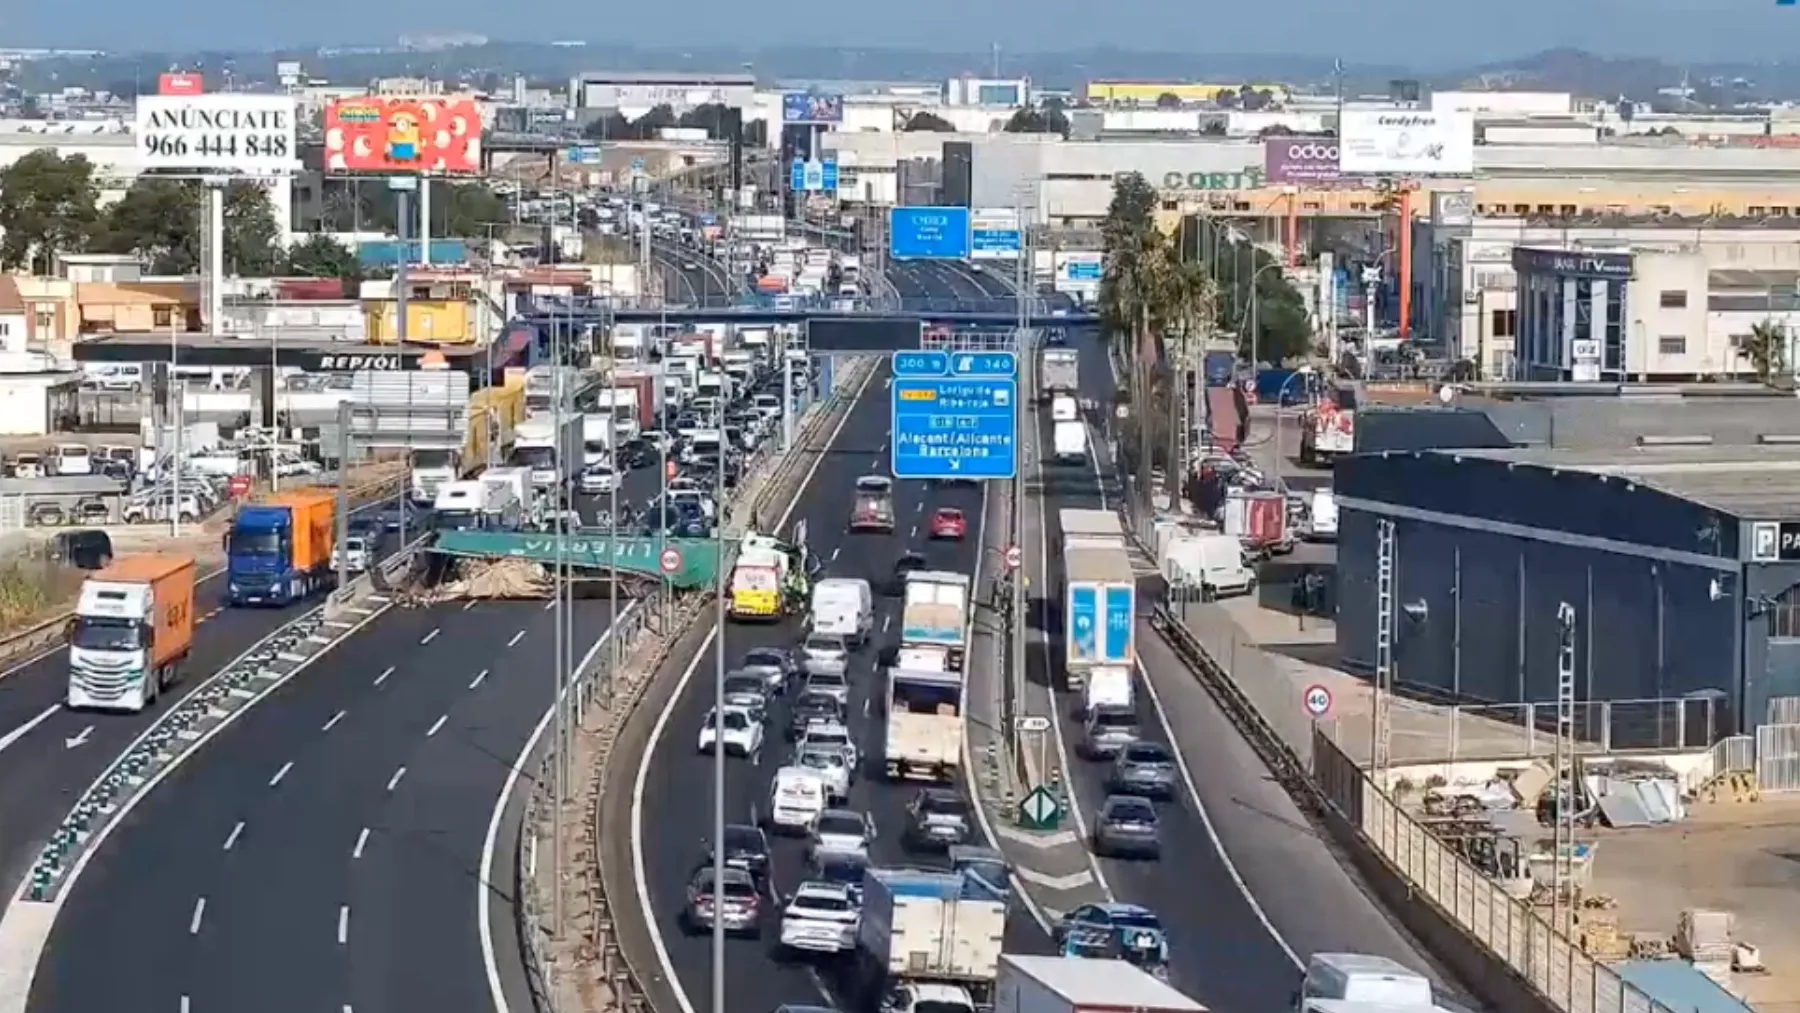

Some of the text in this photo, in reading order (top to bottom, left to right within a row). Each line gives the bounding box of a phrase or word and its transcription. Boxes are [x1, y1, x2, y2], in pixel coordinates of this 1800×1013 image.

[146, 104, 287, 129] ANÚNCIATE
[145, 134, 287, 157] 966 444 848
[1289, 142, 1338, 161] odoo
[320, 355, 399, 370] REPSOL
[984, 358, 1010, 369] 340
[919, 444, 990, 457] Barcelona
[1309, 693, 1326, 706] 40
